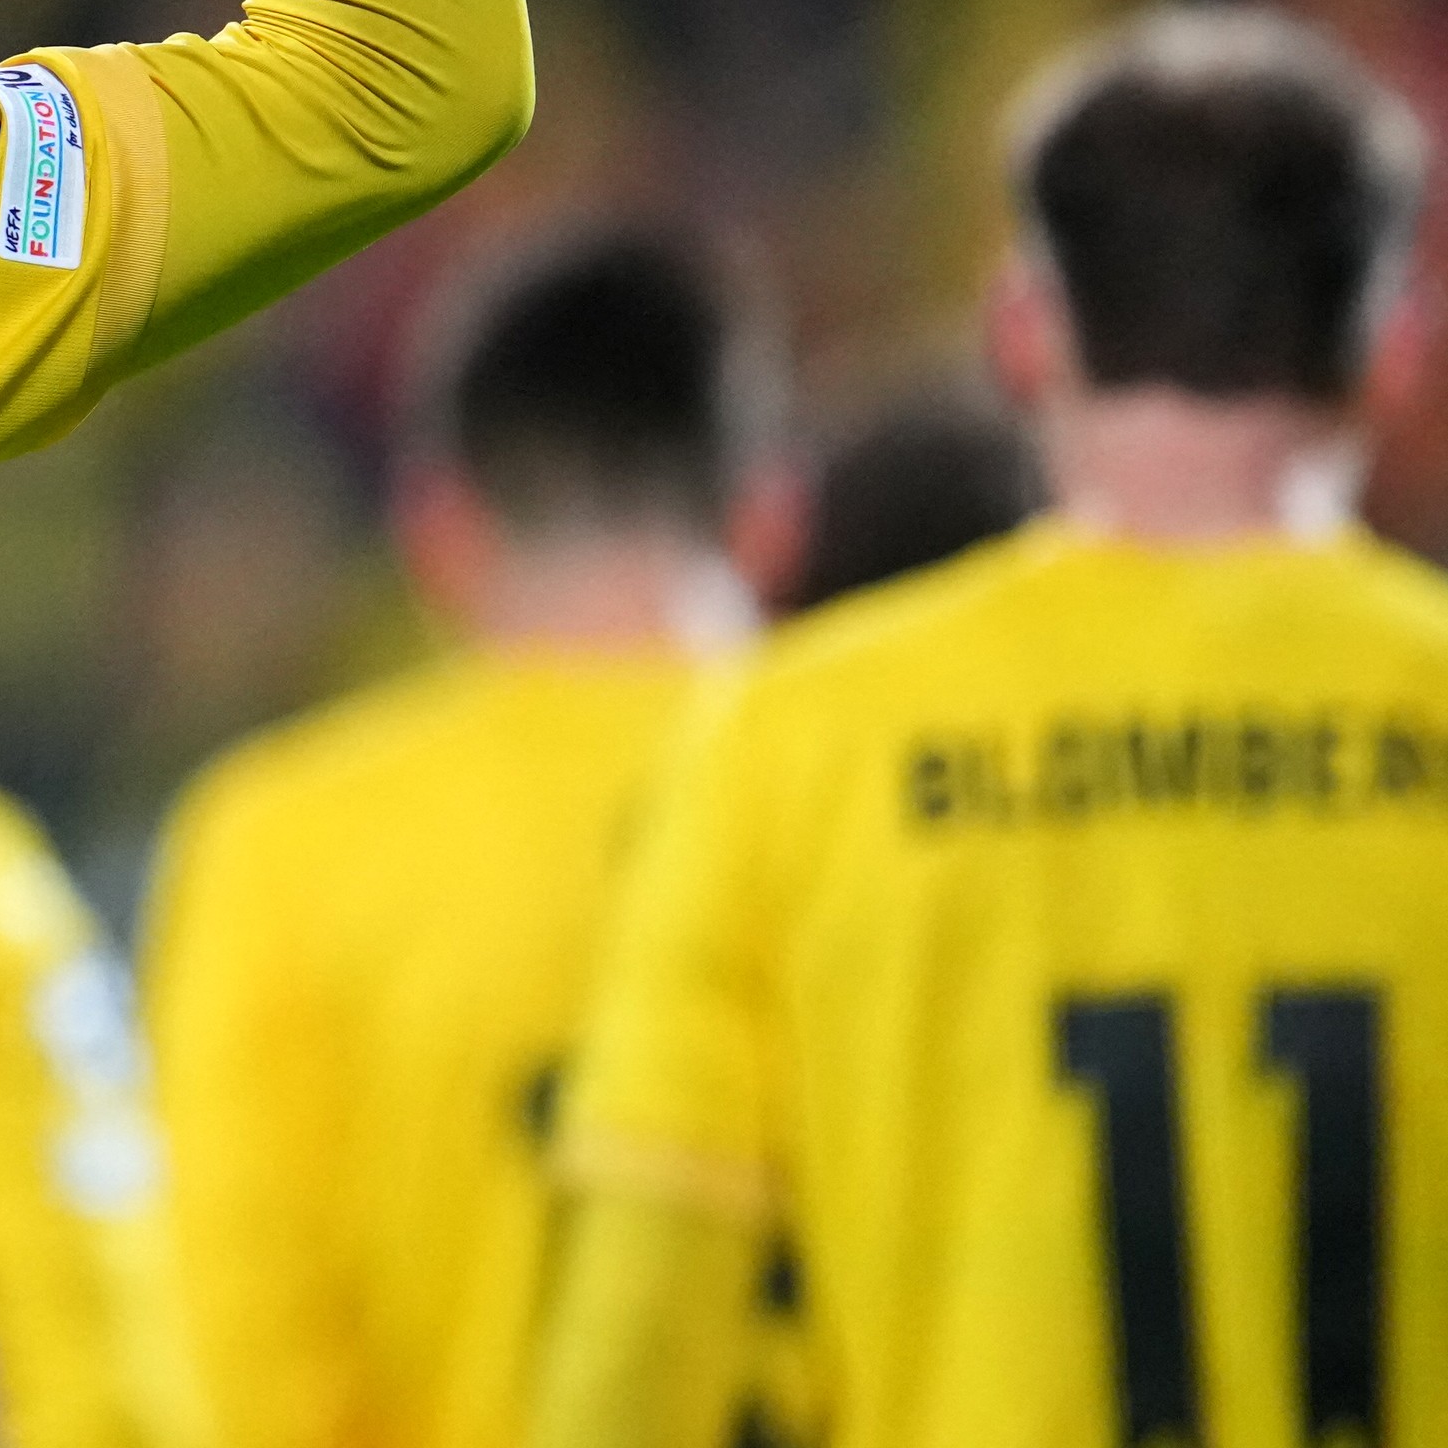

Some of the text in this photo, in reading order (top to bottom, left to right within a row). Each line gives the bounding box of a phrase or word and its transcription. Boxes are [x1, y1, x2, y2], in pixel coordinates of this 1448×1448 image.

[5, 207, 21, 253] UEFA
[26, 91, 56, 258] FOUNDATION
[1053, 987, 1386, 1448] 11
